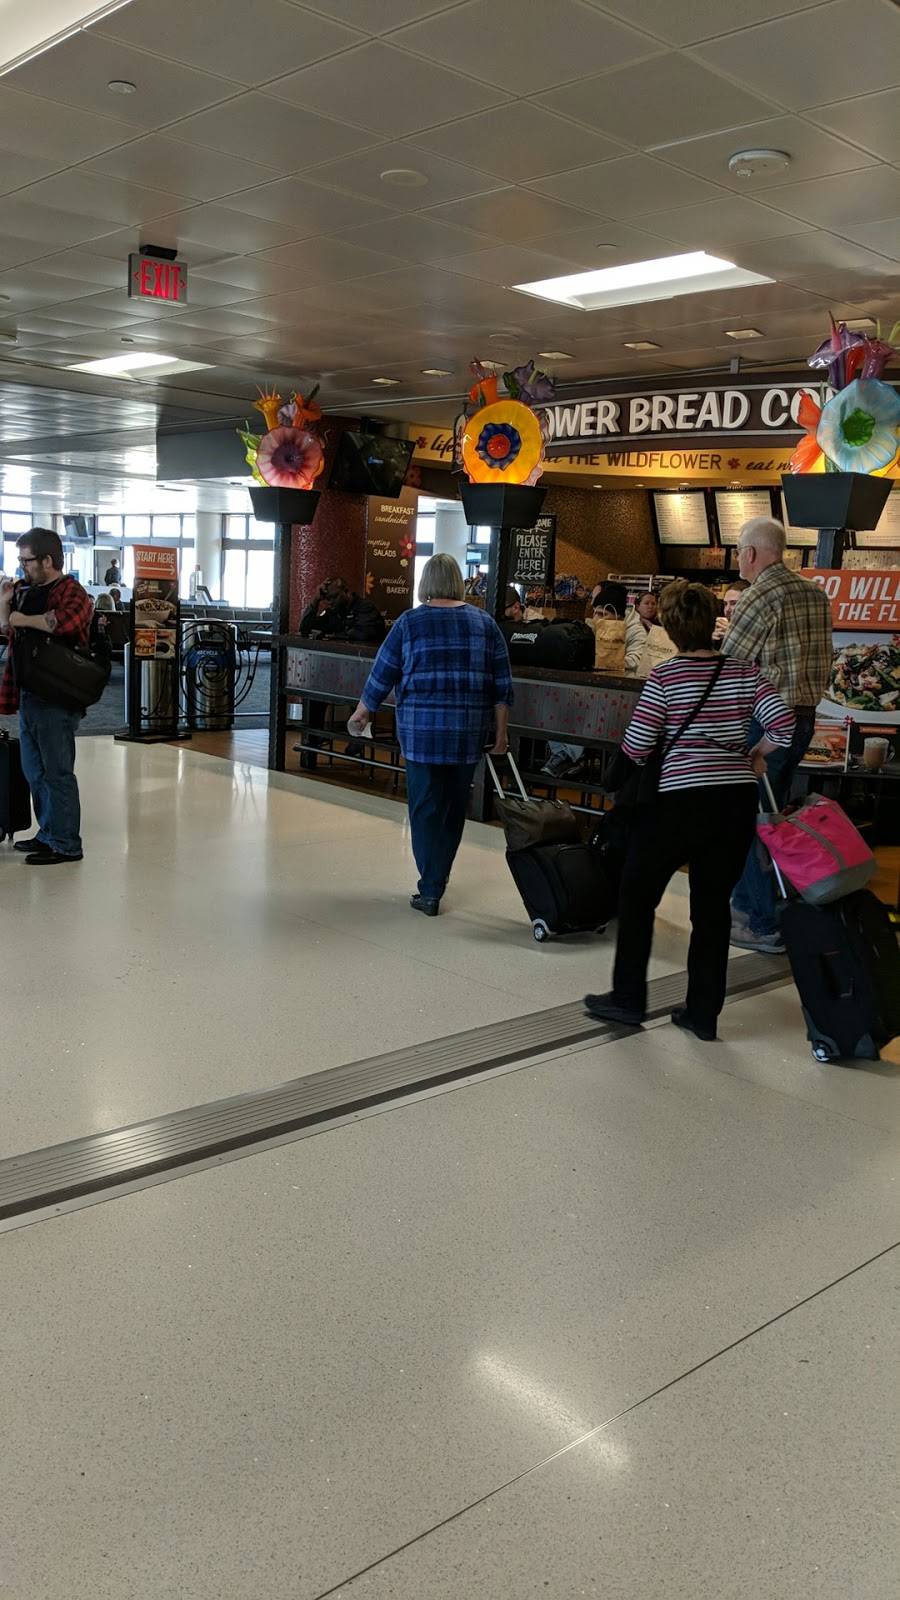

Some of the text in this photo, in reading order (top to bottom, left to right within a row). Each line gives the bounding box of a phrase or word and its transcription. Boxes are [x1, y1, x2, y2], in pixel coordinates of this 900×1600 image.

[141, 260, 181, 300] EXIT
[629, 390, 750, 434] BREAD
[568, 455, 600, 465] THE
[607, 453, 721, 470] WILDFLOWER
[746, 460, 774, 470] eat
[381, 505, 414, 515] BREAKFAST
[516, 534, 547, 548] PLEASE
[136, 551, 175, 564] START HERE
[373, 549, 397, 557] SALADS
[519, 548, 546, 558] ENTER
[517, 559, 545, 571] HERE!
[838, 602, 900, 621] THE FL
